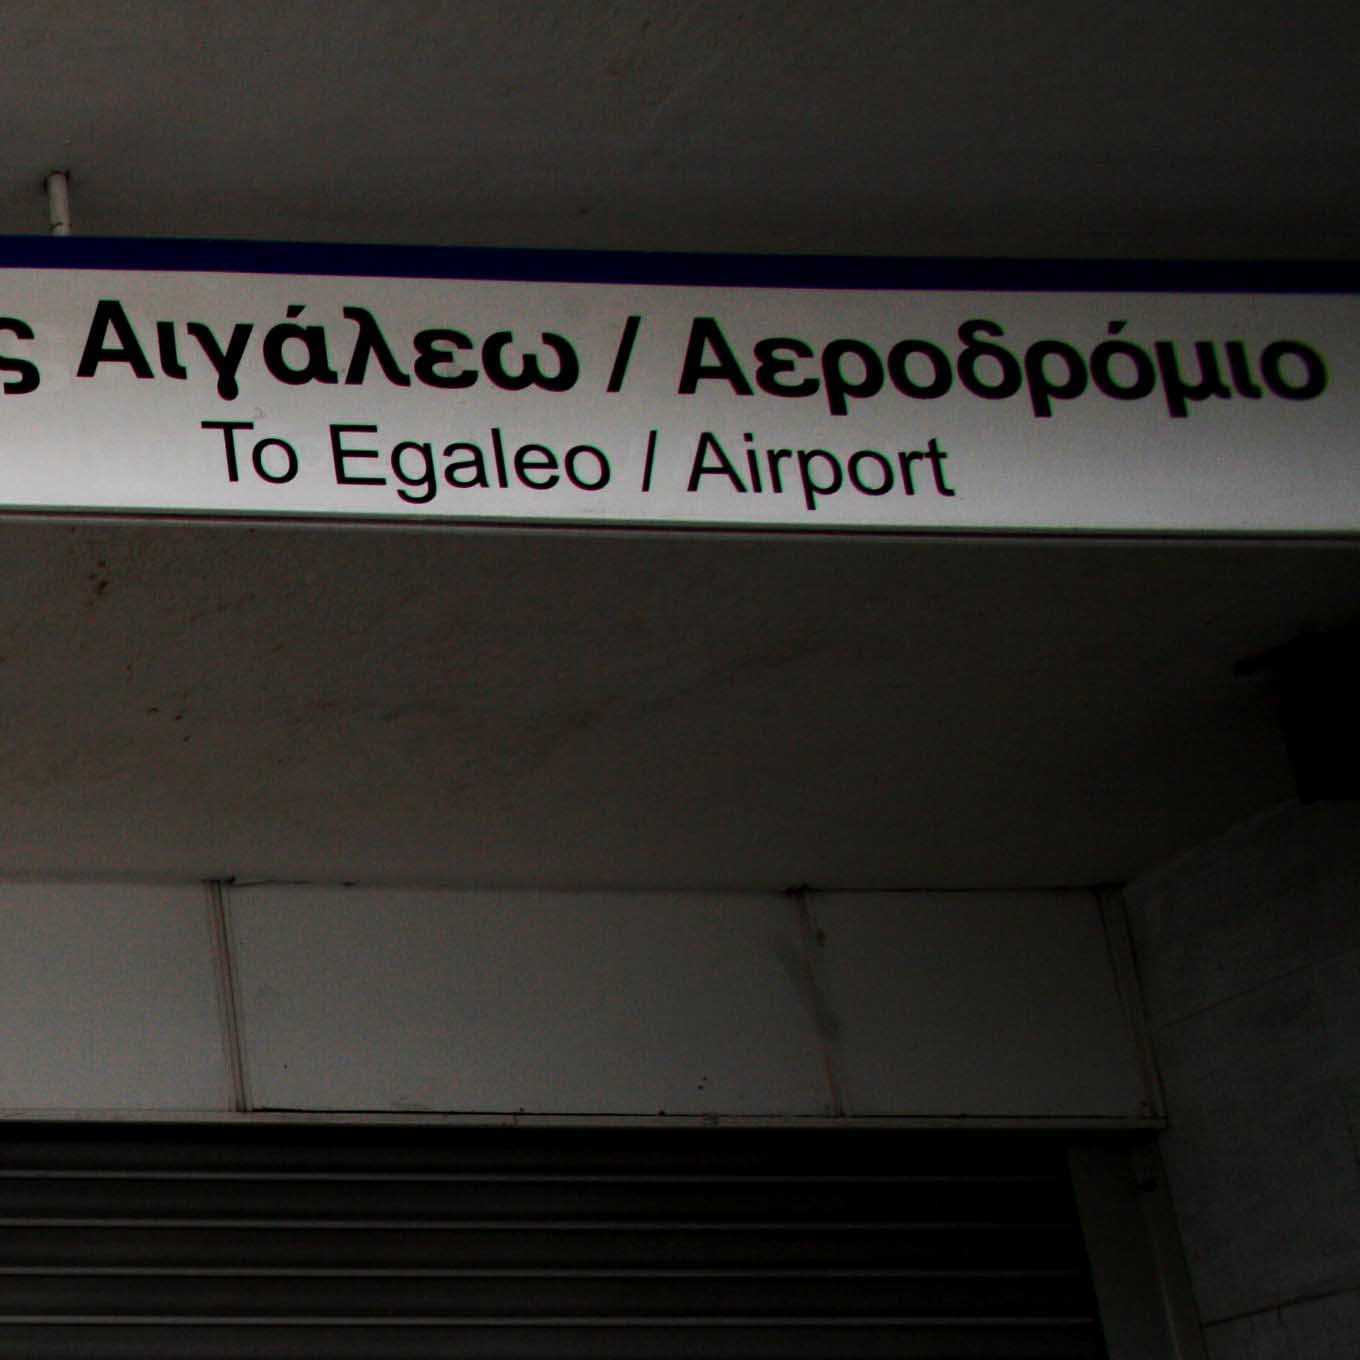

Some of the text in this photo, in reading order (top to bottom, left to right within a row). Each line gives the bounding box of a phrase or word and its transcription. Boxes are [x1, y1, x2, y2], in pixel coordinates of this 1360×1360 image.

[76, 299, 580, 401] Αιγάλεω
[606, 315, 641, 393] /
[677, 317, 1329, 419] Αεροδρόμιο
[200, 420, 956, 511] To Egaleo / Airport
